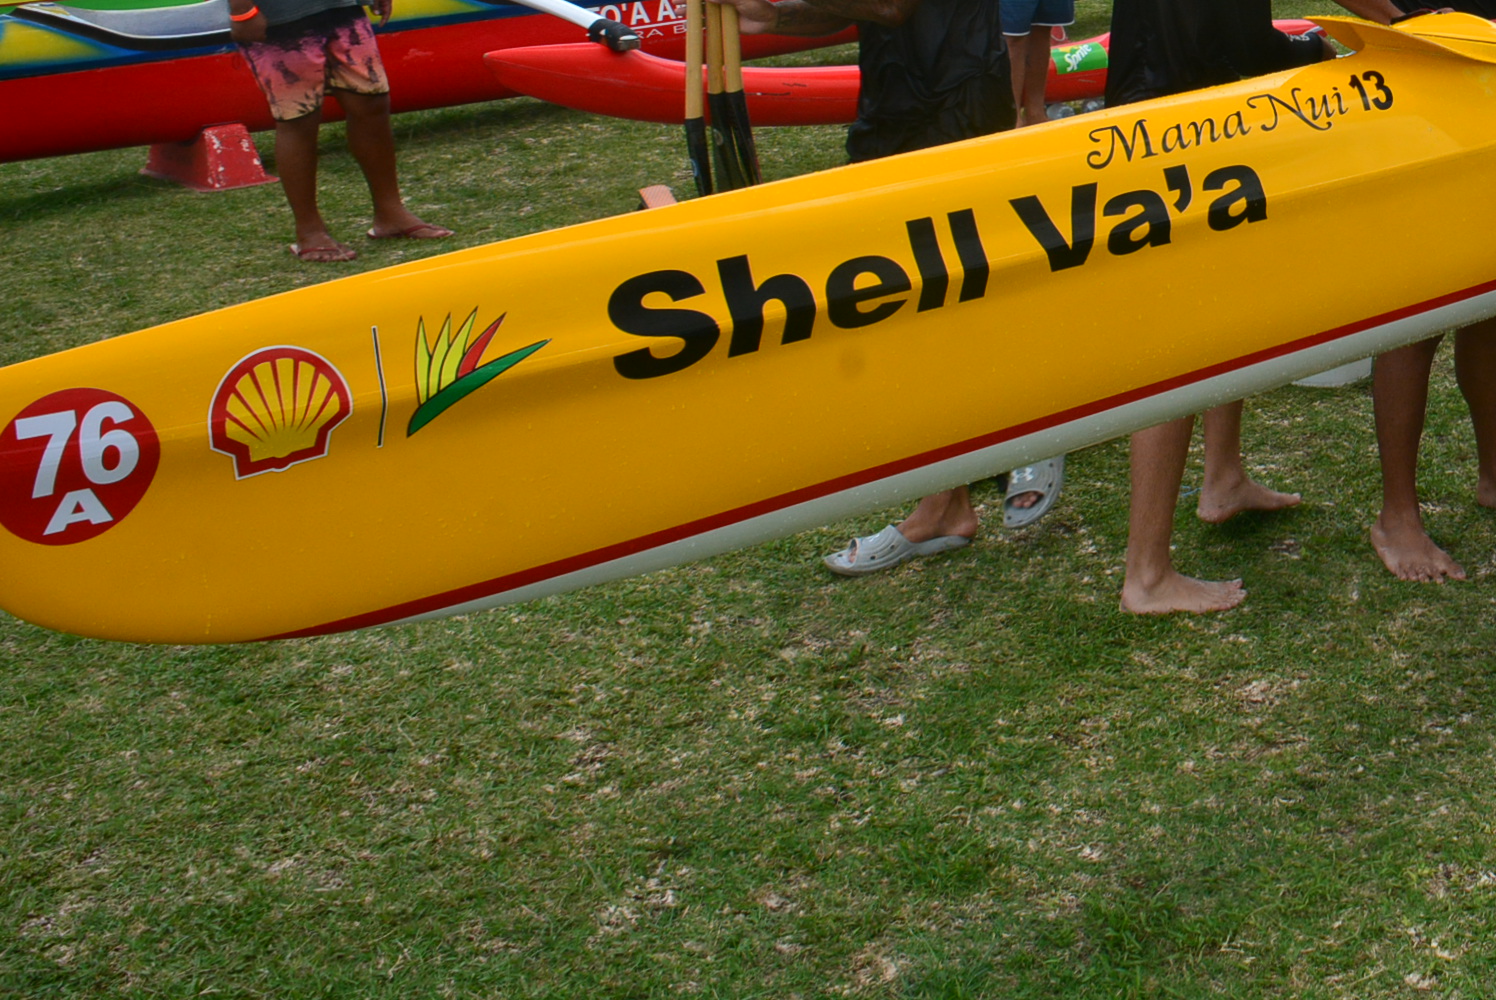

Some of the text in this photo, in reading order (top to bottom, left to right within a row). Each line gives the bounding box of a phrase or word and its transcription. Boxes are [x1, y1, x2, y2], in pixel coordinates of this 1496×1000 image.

[1064, 43, 1092, 72] Sprite
[1086, 70, 1394, 170] Mana Nui 13
[606, 207, 990, 381] Shell
[15, 400, 140, 499] 76
[42, 487, 114, 536] A
